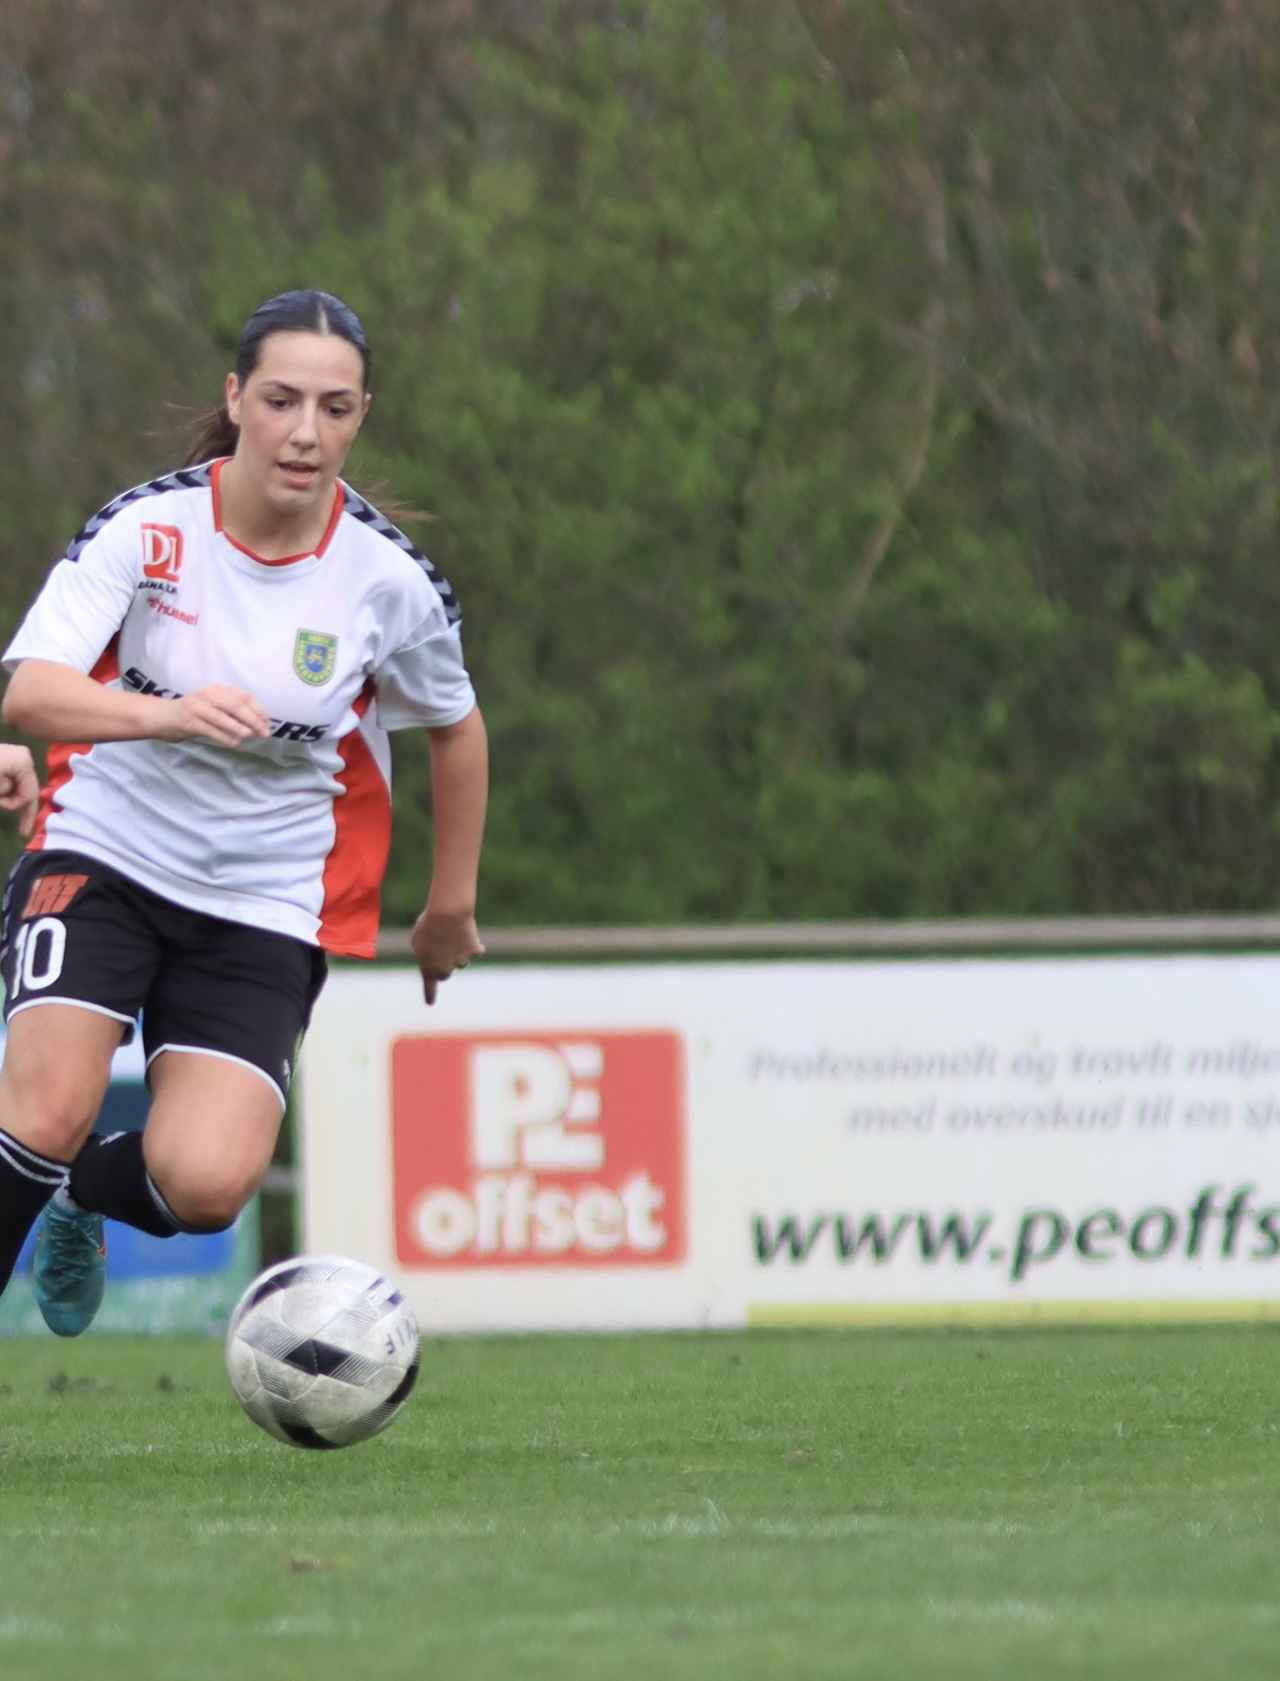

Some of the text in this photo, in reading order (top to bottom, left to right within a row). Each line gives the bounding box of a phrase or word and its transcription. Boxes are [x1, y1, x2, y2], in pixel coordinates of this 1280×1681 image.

[122, 666, 331, 743] SKERS
[10, 916, 67, 1001] 10
[413, 1173, 667, 1258] offset
